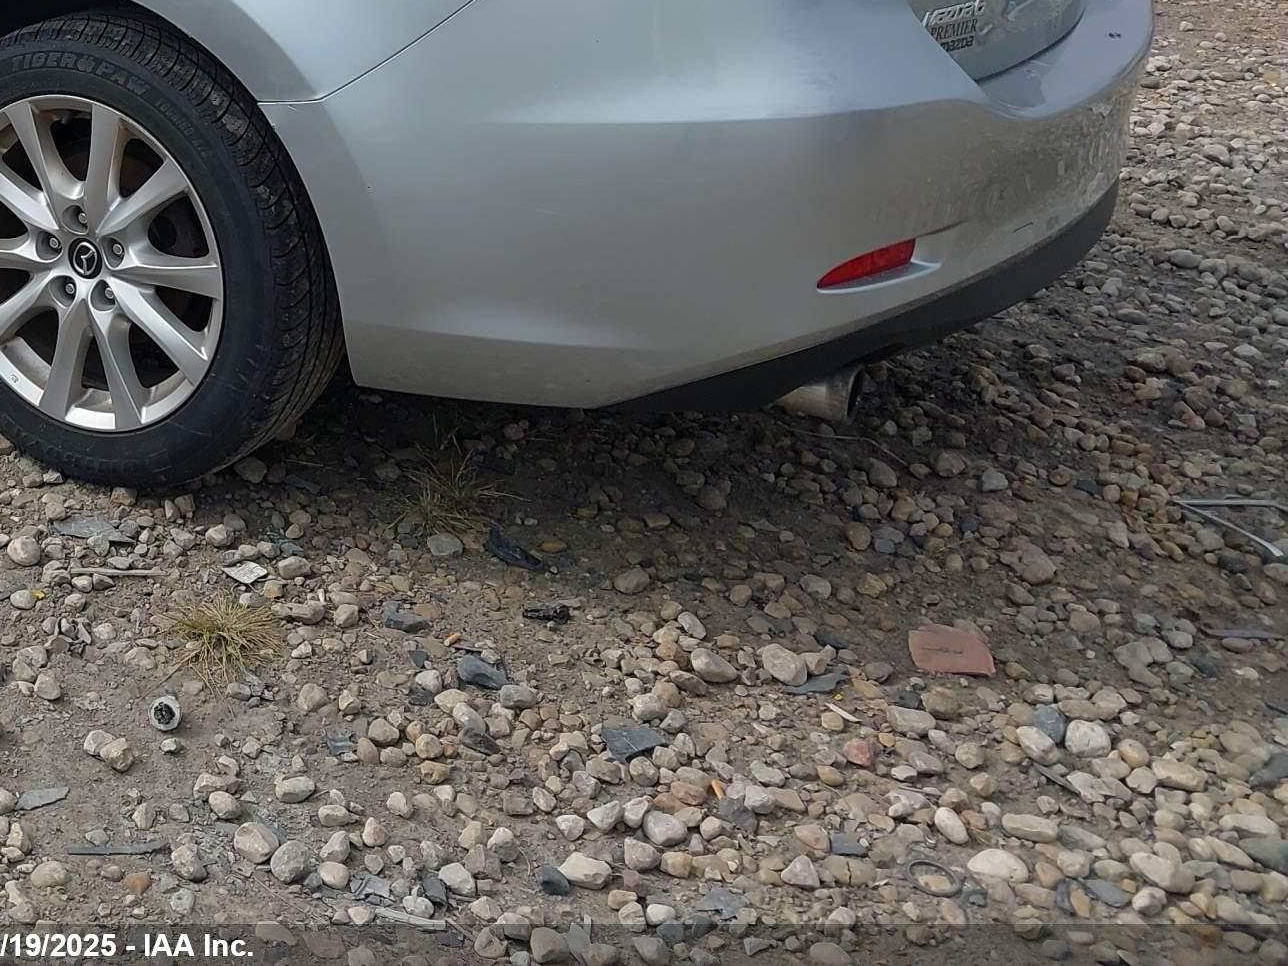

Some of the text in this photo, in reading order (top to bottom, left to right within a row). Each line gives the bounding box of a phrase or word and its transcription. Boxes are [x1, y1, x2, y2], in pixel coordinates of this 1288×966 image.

[930, 18, 978, 41] PREMIER
[11, 52, 75, 71] TIGER
[95, 62, 152, 95] PAW
